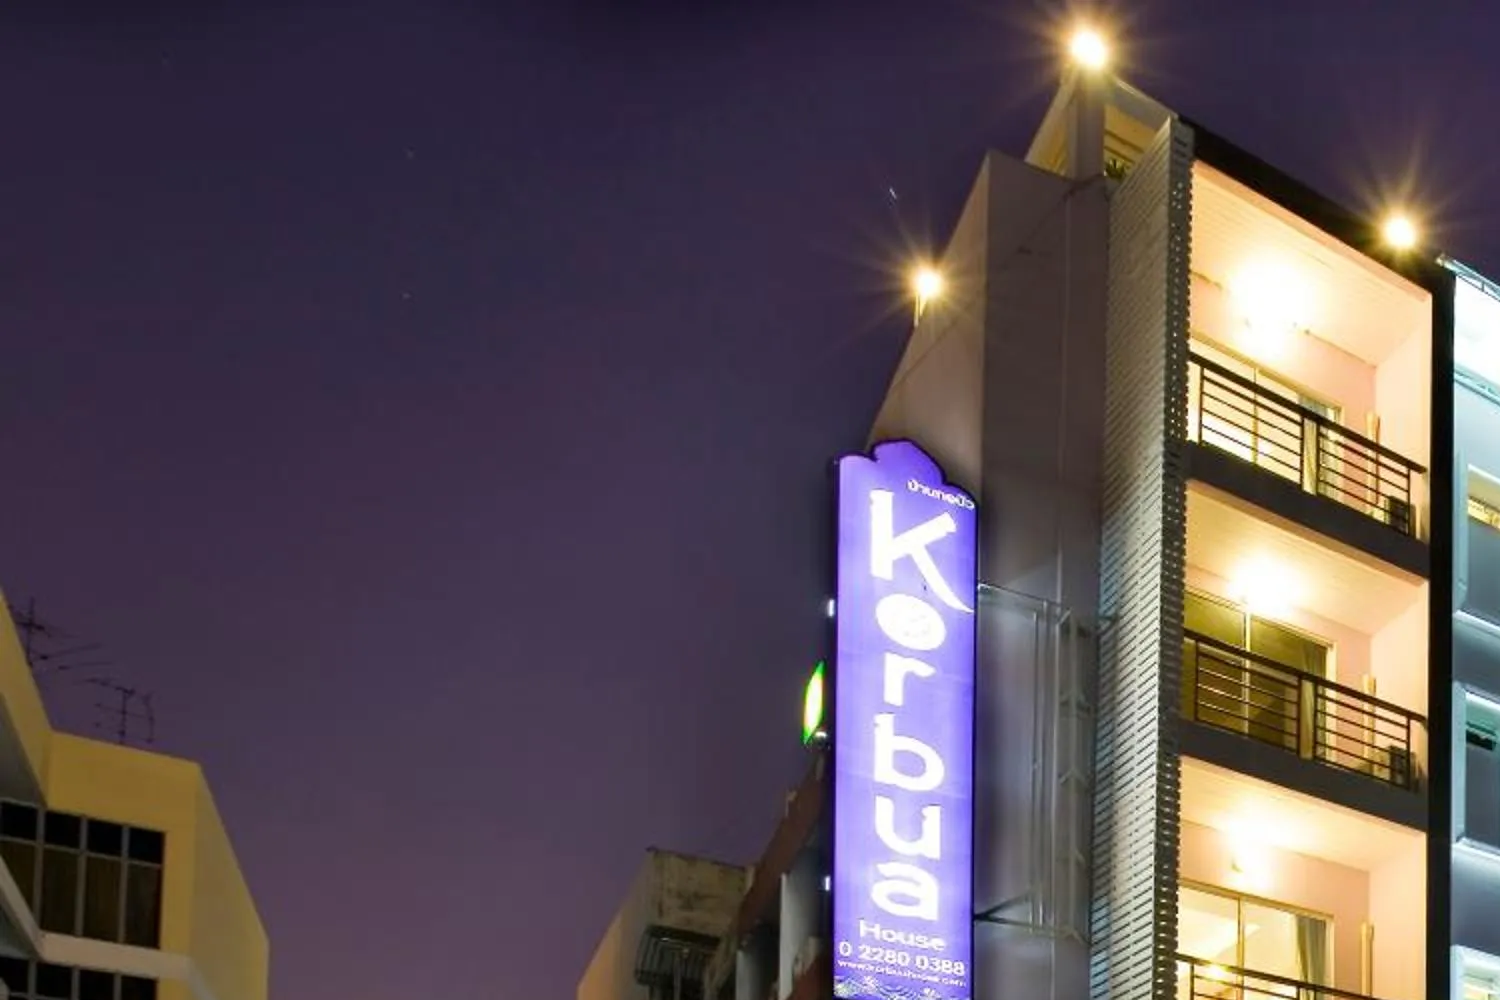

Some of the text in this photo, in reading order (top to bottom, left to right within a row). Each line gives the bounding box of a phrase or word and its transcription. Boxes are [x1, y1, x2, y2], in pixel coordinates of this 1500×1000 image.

[858, 920, 946, 951] House
[838, 940, 966, 976] 0 2280 0388
